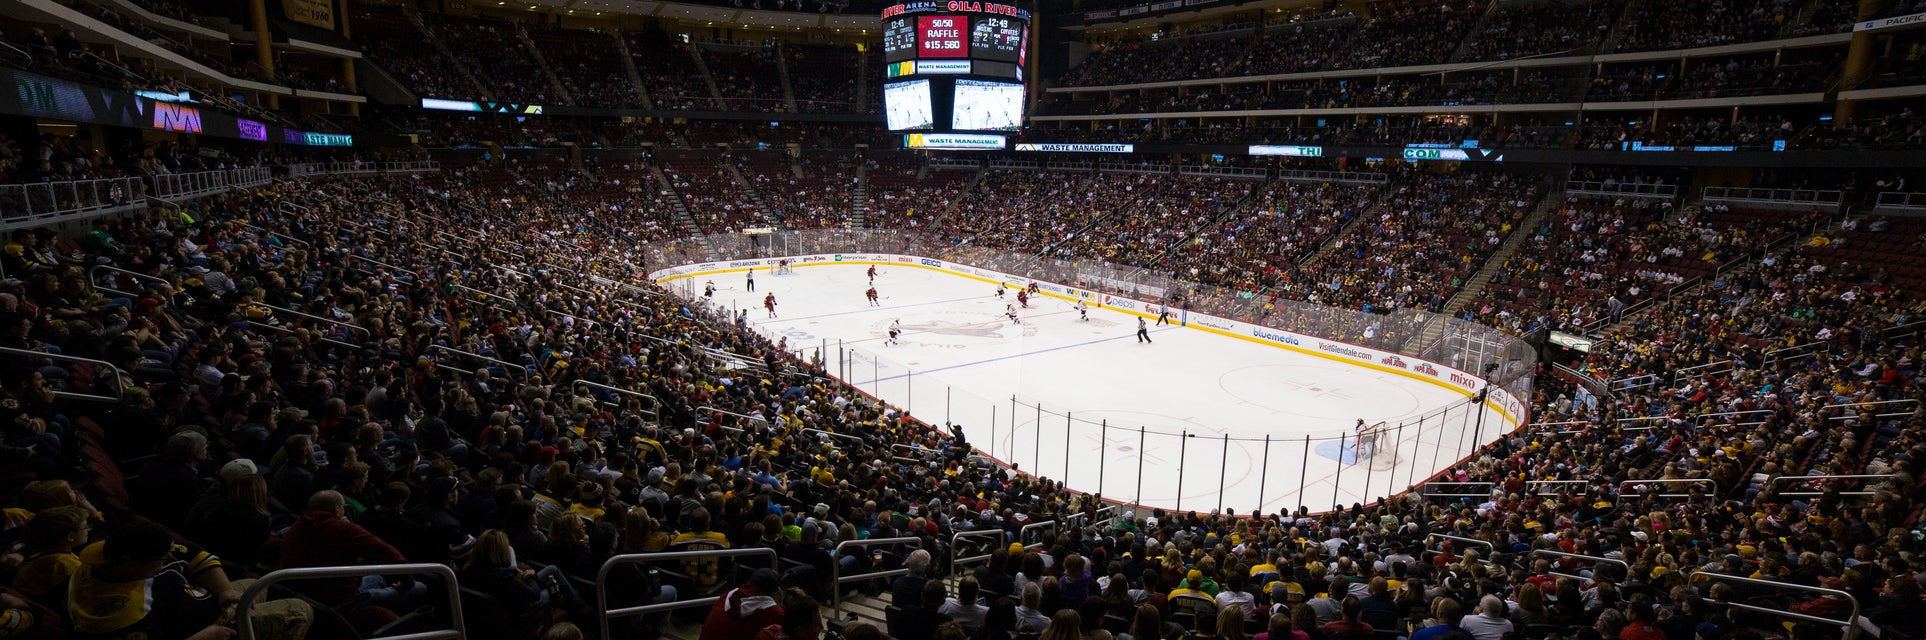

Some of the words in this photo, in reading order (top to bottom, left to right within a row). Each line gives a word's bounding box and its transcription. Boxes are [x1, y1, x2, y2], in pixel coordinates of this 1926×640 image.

[948, 1, 982, 12] GILA
[985, 2, 1017, 17] RIVER
[311, 10, 329, 21] 1960
[1886, 14, 1924, 25] PACIFIC
[932, 19, 953, 27] 50/50
[988, 17, 1008, 28] 12:43
[927, 29, 959, 38] RAFFLE
[889, 61, 913, 76] WM
[1298, 147, 1321, 155] THI
[1405, 149, 1440, 158] COM
[921, 258, 941, 268] GEICO
[1112, 297, 1136, 309] pepsi
[1253, 327, 1299, 346] bluemedia
[1318, 341, 1372, 361] VisitGlendale.com
